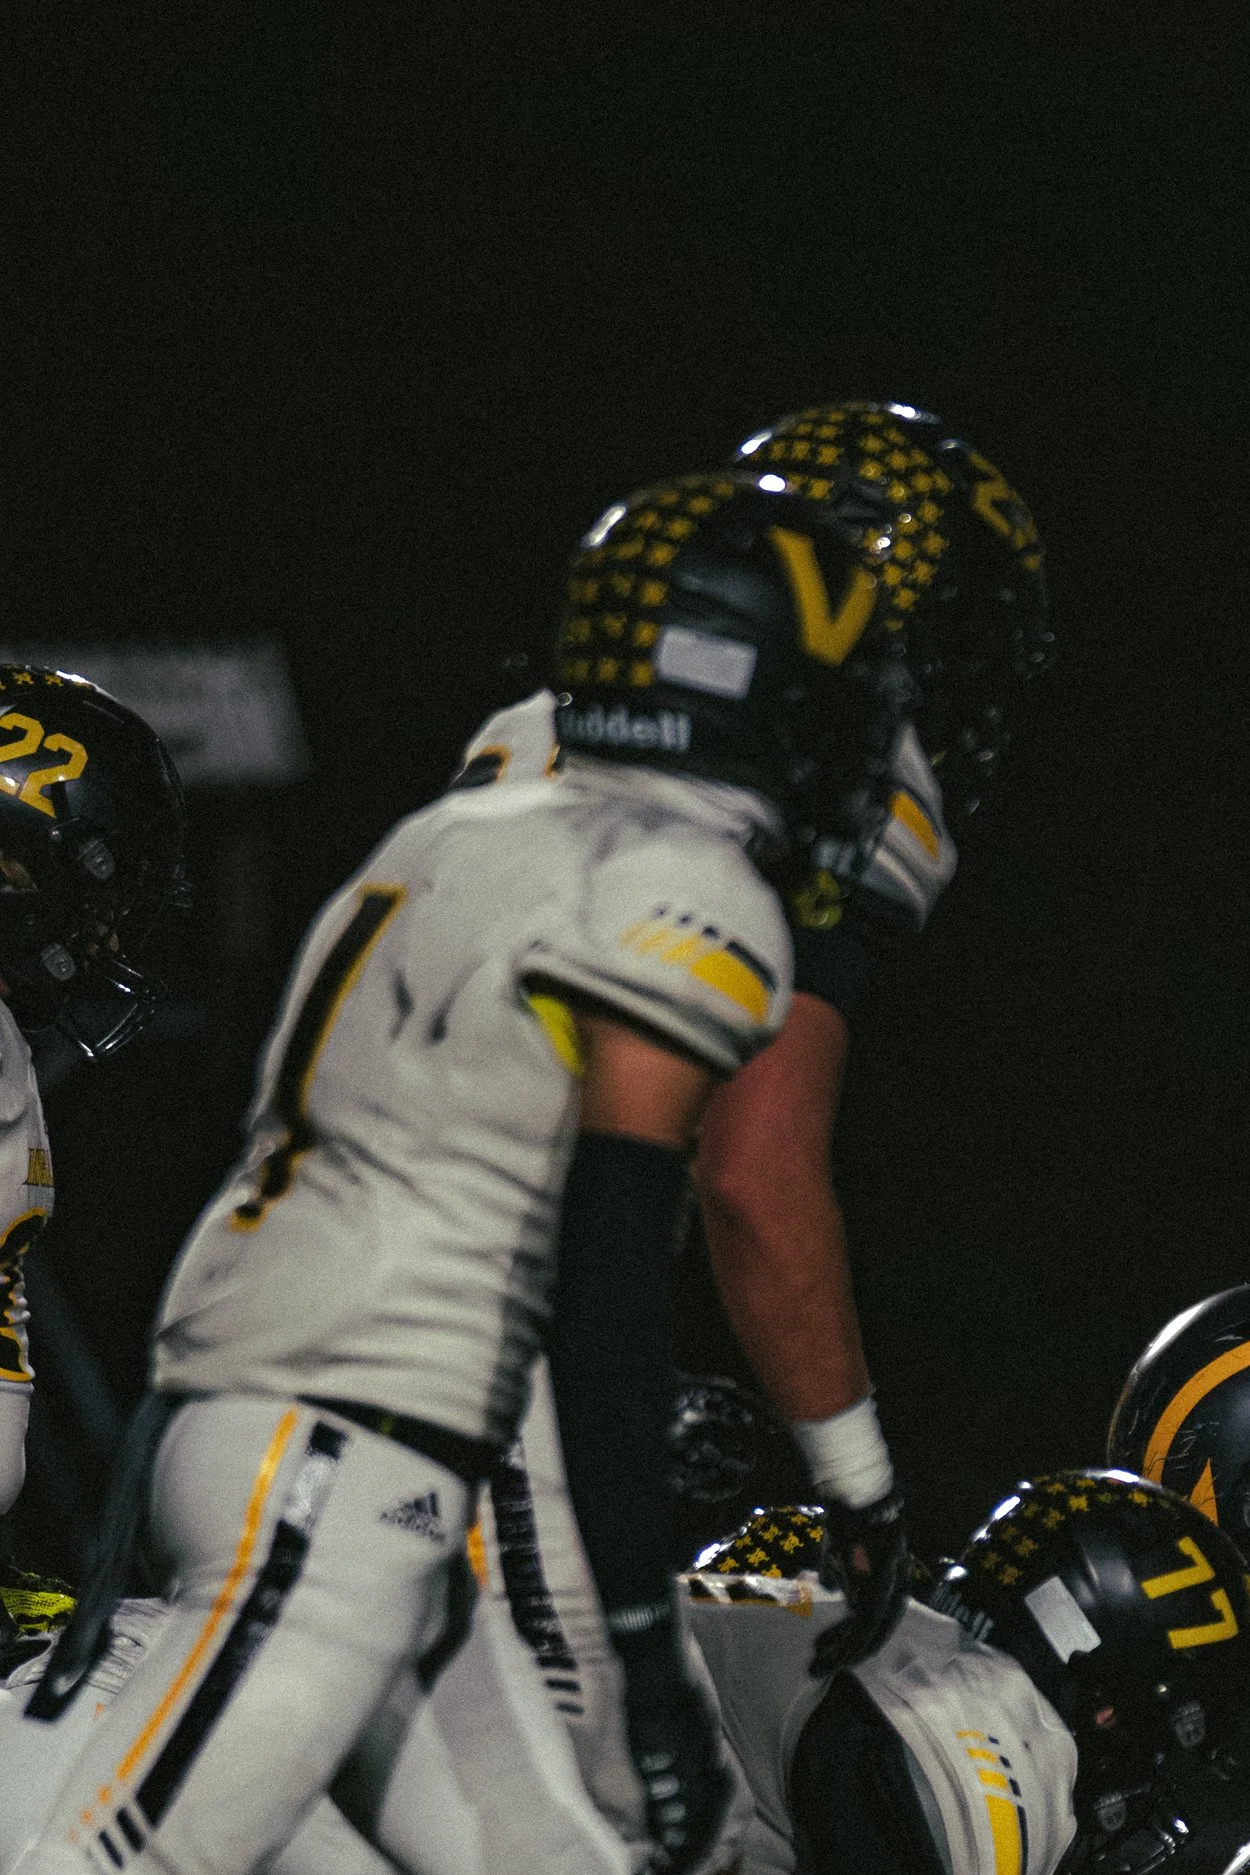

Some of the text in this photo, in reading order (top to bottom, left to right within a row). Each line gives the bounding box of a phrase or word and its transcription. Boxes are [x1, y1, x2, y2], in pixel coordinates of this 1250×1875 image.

[769, 525, 880, 667] V
[0, 711, 88, 818] 22
[1140, 1535, 1239, 1649] 77
